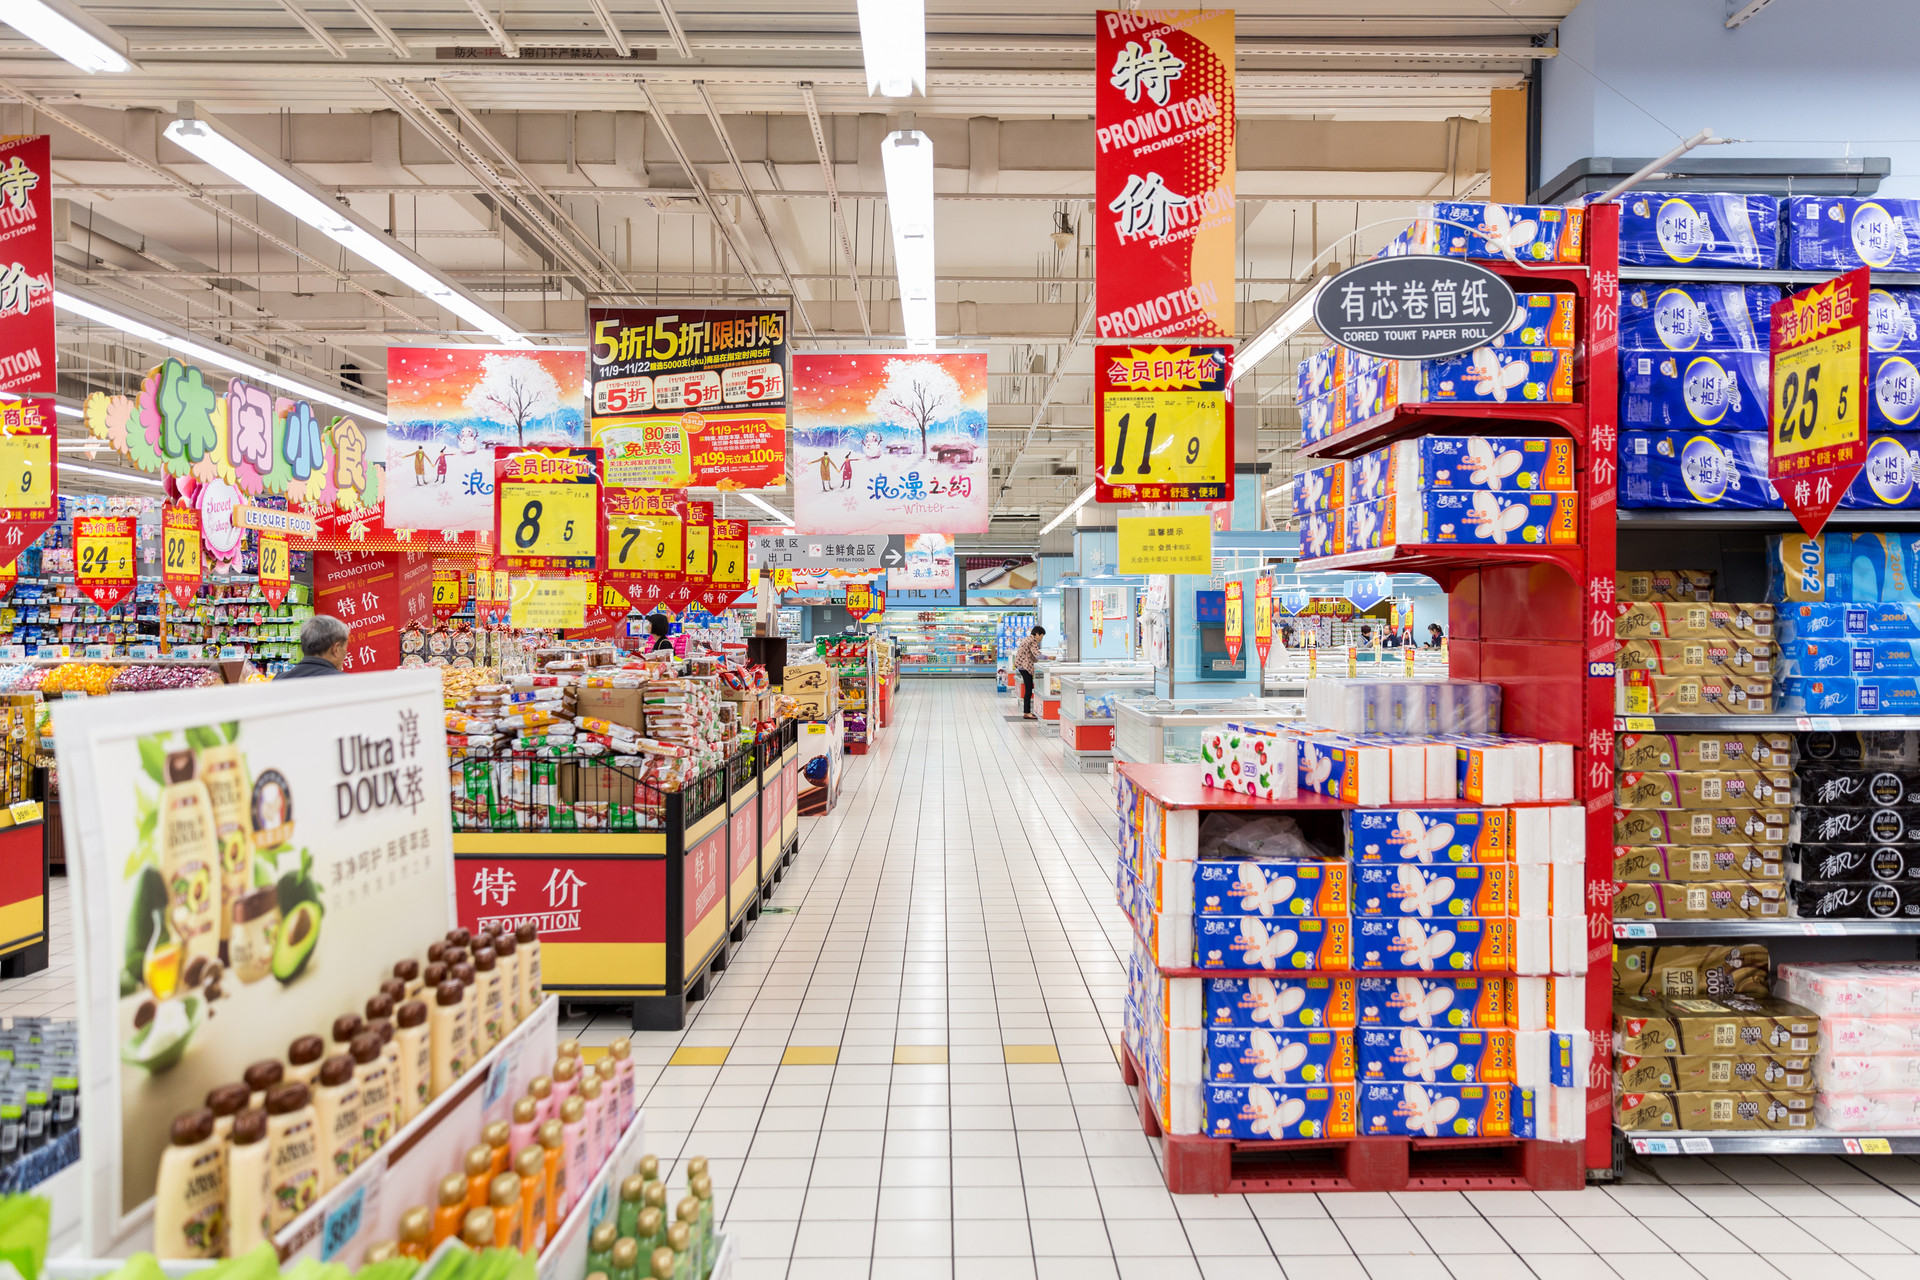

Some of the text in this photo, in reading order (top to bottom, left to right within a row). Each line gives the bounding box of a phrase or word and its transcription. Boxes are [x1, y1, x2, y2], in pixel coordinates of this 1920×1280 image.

[1110, 39, 1185, 106] 特
[1097, 92, 1218, 153] PROMOTION
[1133, 123, 1217, 158] PROMOTION
[1108, 172, 1189, 238] 价
[1149, 215, 1232, 249] PROMOTION
[1097, 280, 1219, 337] PROMOTION
[1340, 279, 1490, 322] 有芯卷筒纸
[1592, 270, 1617, 332] 特价
[1781, 290, 1853, 342] 特价商品
[1343, 331, 1379, 342] CORED
[1422, 329, 1456, 340] PAPER
[1461, 328, 1488, 339] ROLL
[1108, 358, 1219, 385] 会员印花价
[645, 427, 663, 440] 80
[1591, 424, 1616, 485] 特价
[207, 497, 231, 513] Sweet
[616, 494, 675, 511] 特价商品
[1794, 476, 1833, 507] 特价
[246, 510, 311, 532] LEISURE FOOD
[761, 538, 799, 548] 收银区
[768, 553, 792, 562] 出口
[825, 544, 876, 556] 生鲜食品区
[328, 560, 386, 582] PROMOTION
[1800, 540, 1822, 594] 10+2
[94, 588, 119, 599] 特价
[337, 591, 380, 617] 特价
[629, 584, 661, 599] 特价
[703, 592, 728, 603] 特价
[1590, 577, 1615, 638] 特价
[1590, 664, 1615, 676] 053
[338, 734, 395, 776] Ultra
[1589, 728, 1613, 789] 特价
[336, 768, 404, 820] DOUX
[473, 867, 587, 909] 特价
[1587, 879, 1612, 940] 特价
[1589, 1029, 1612, 1090] 特价
